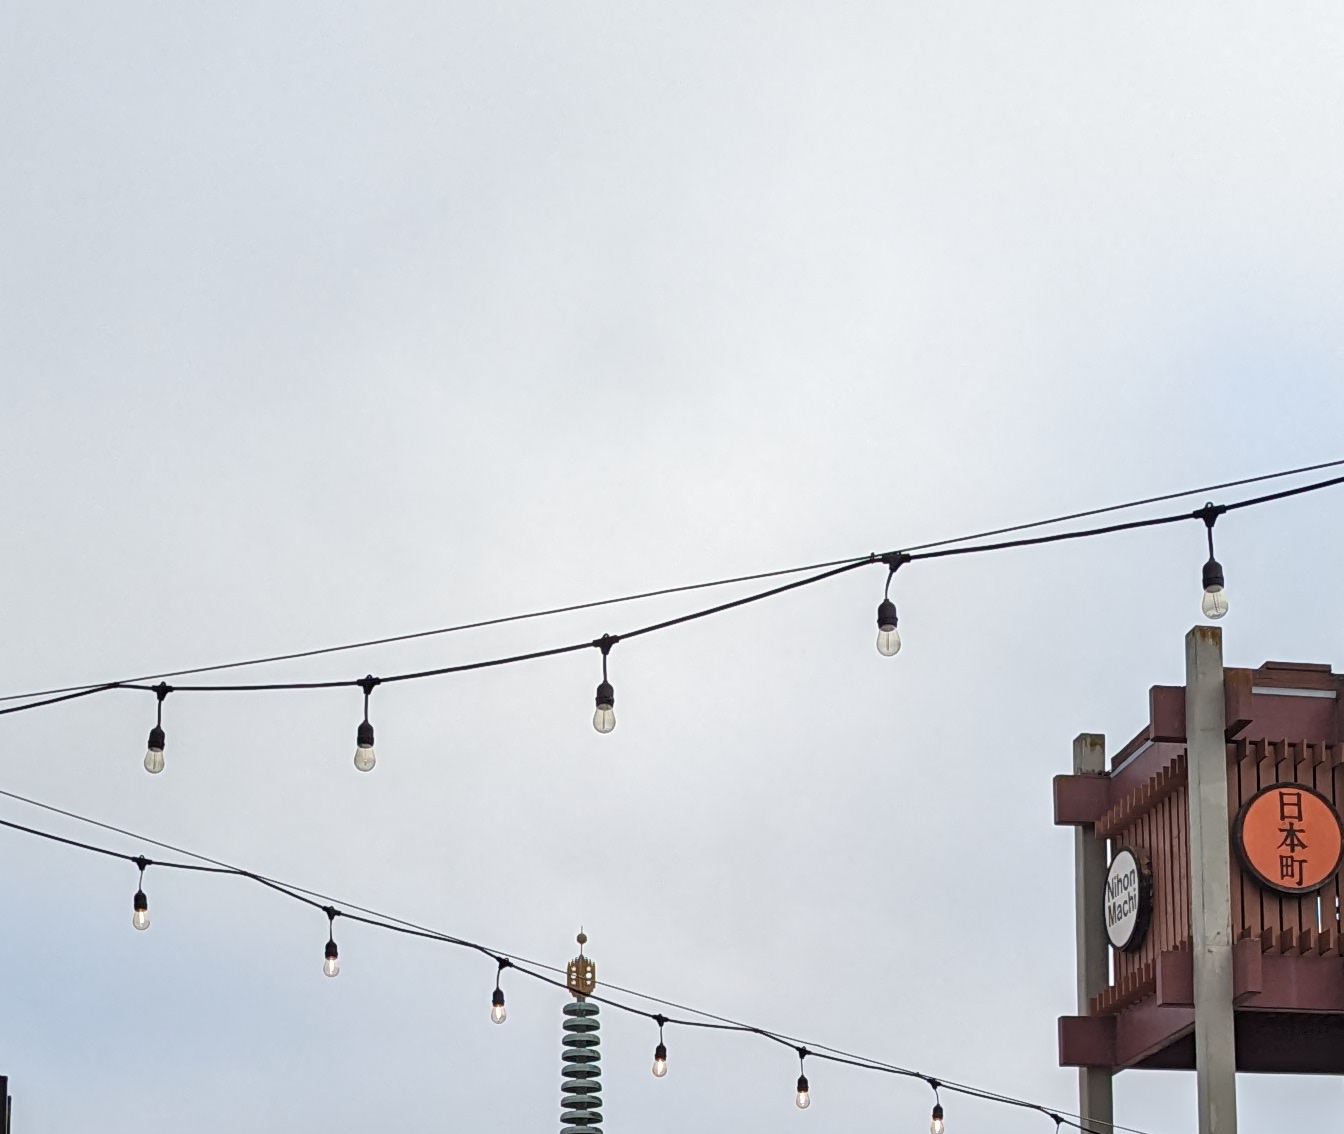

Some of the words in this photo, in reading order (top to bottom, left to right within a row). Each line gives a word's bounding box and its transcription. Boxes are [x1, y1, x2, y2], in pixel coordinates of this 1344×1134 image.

[1276, 790, 1308, 887] 日本町
[1107, 868, 1136, 903] Nihon
[1107, 888, 1137, 927] Machi
